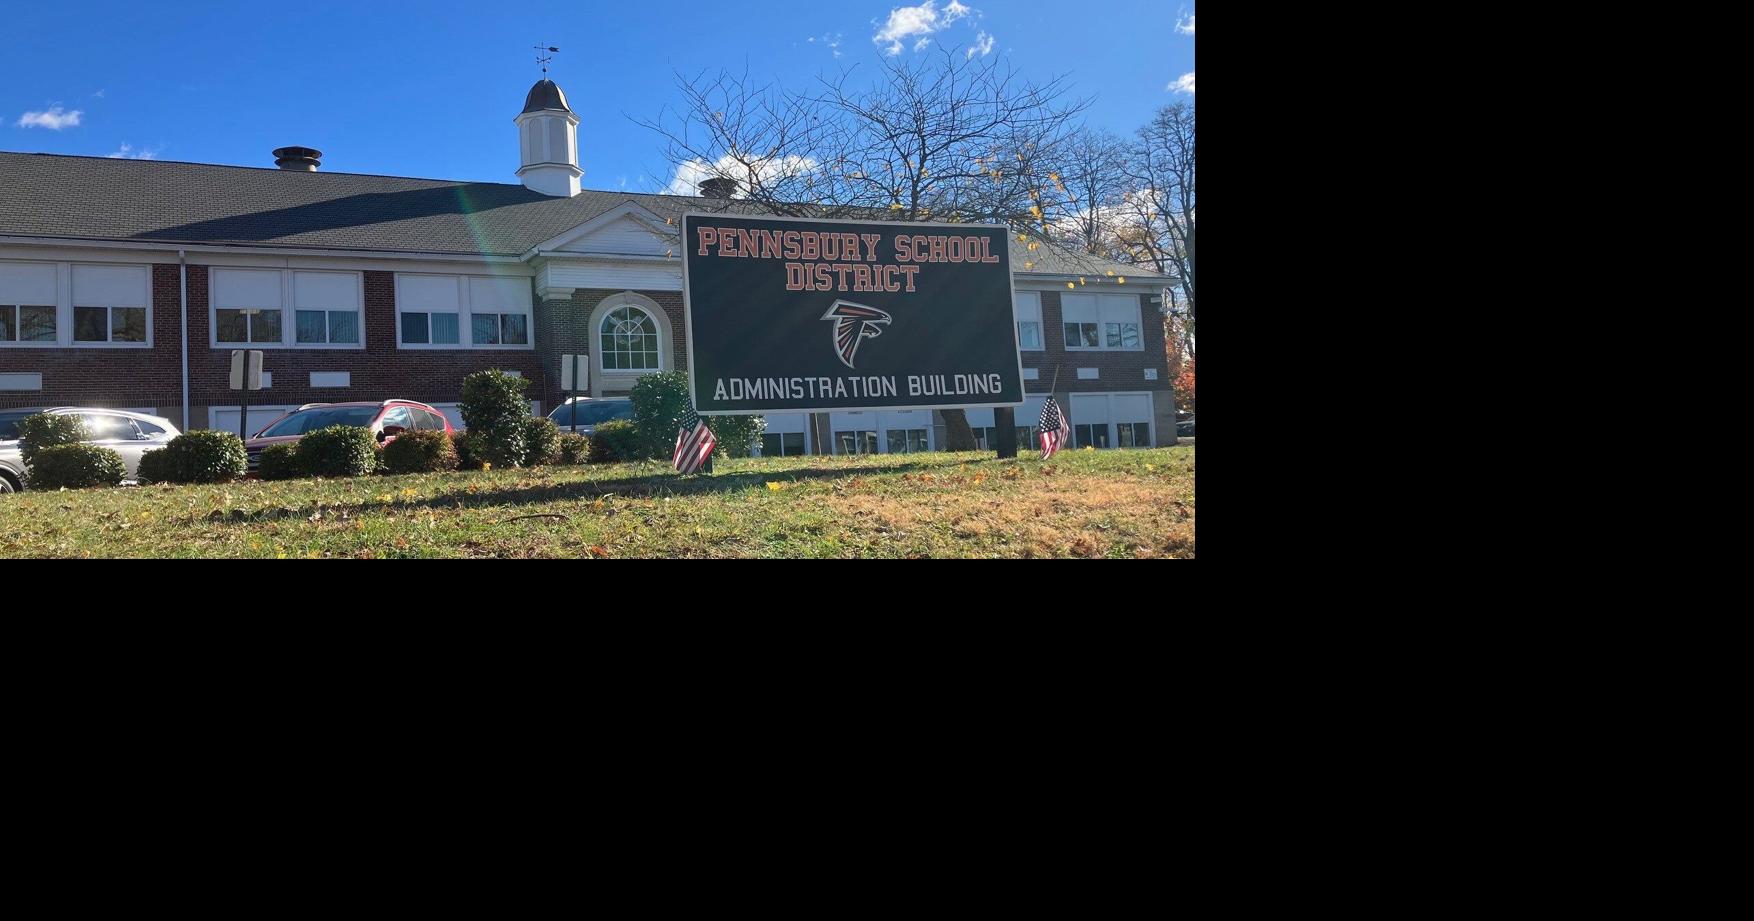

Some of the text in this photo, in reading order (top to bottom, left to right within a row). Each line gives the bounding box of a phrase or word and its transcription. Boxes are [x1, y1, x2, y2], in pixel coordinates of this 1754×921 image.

[697, 226, 1000, 263] PENNSBURY SCHOOL
[785, 262, 920, 293] DISTRICT
[713, 373, 1002, 401] ADMINISTRATION BUILDING
